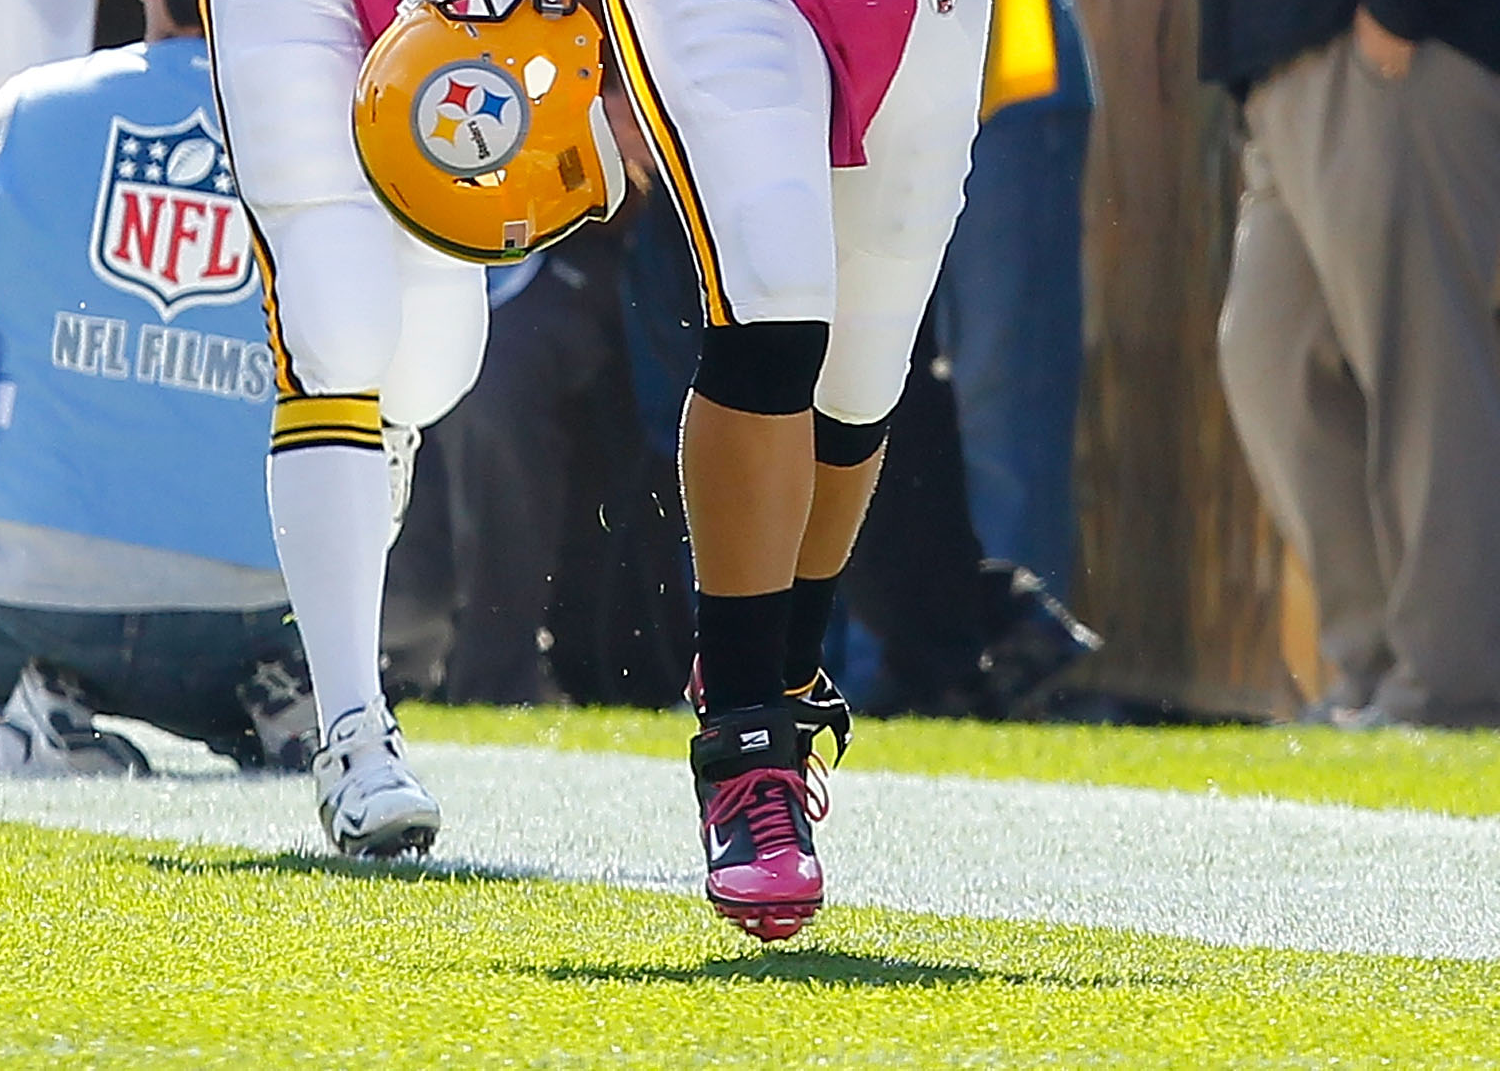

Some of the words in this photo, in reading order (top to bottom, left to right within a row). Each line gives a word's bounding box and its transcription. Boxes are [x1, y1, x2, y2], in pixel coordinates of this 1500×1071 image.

[112, 192, 242, 283] NFL
[52, 311, 129, 380] NFL
[136, 323, 275, 403] FILMS
